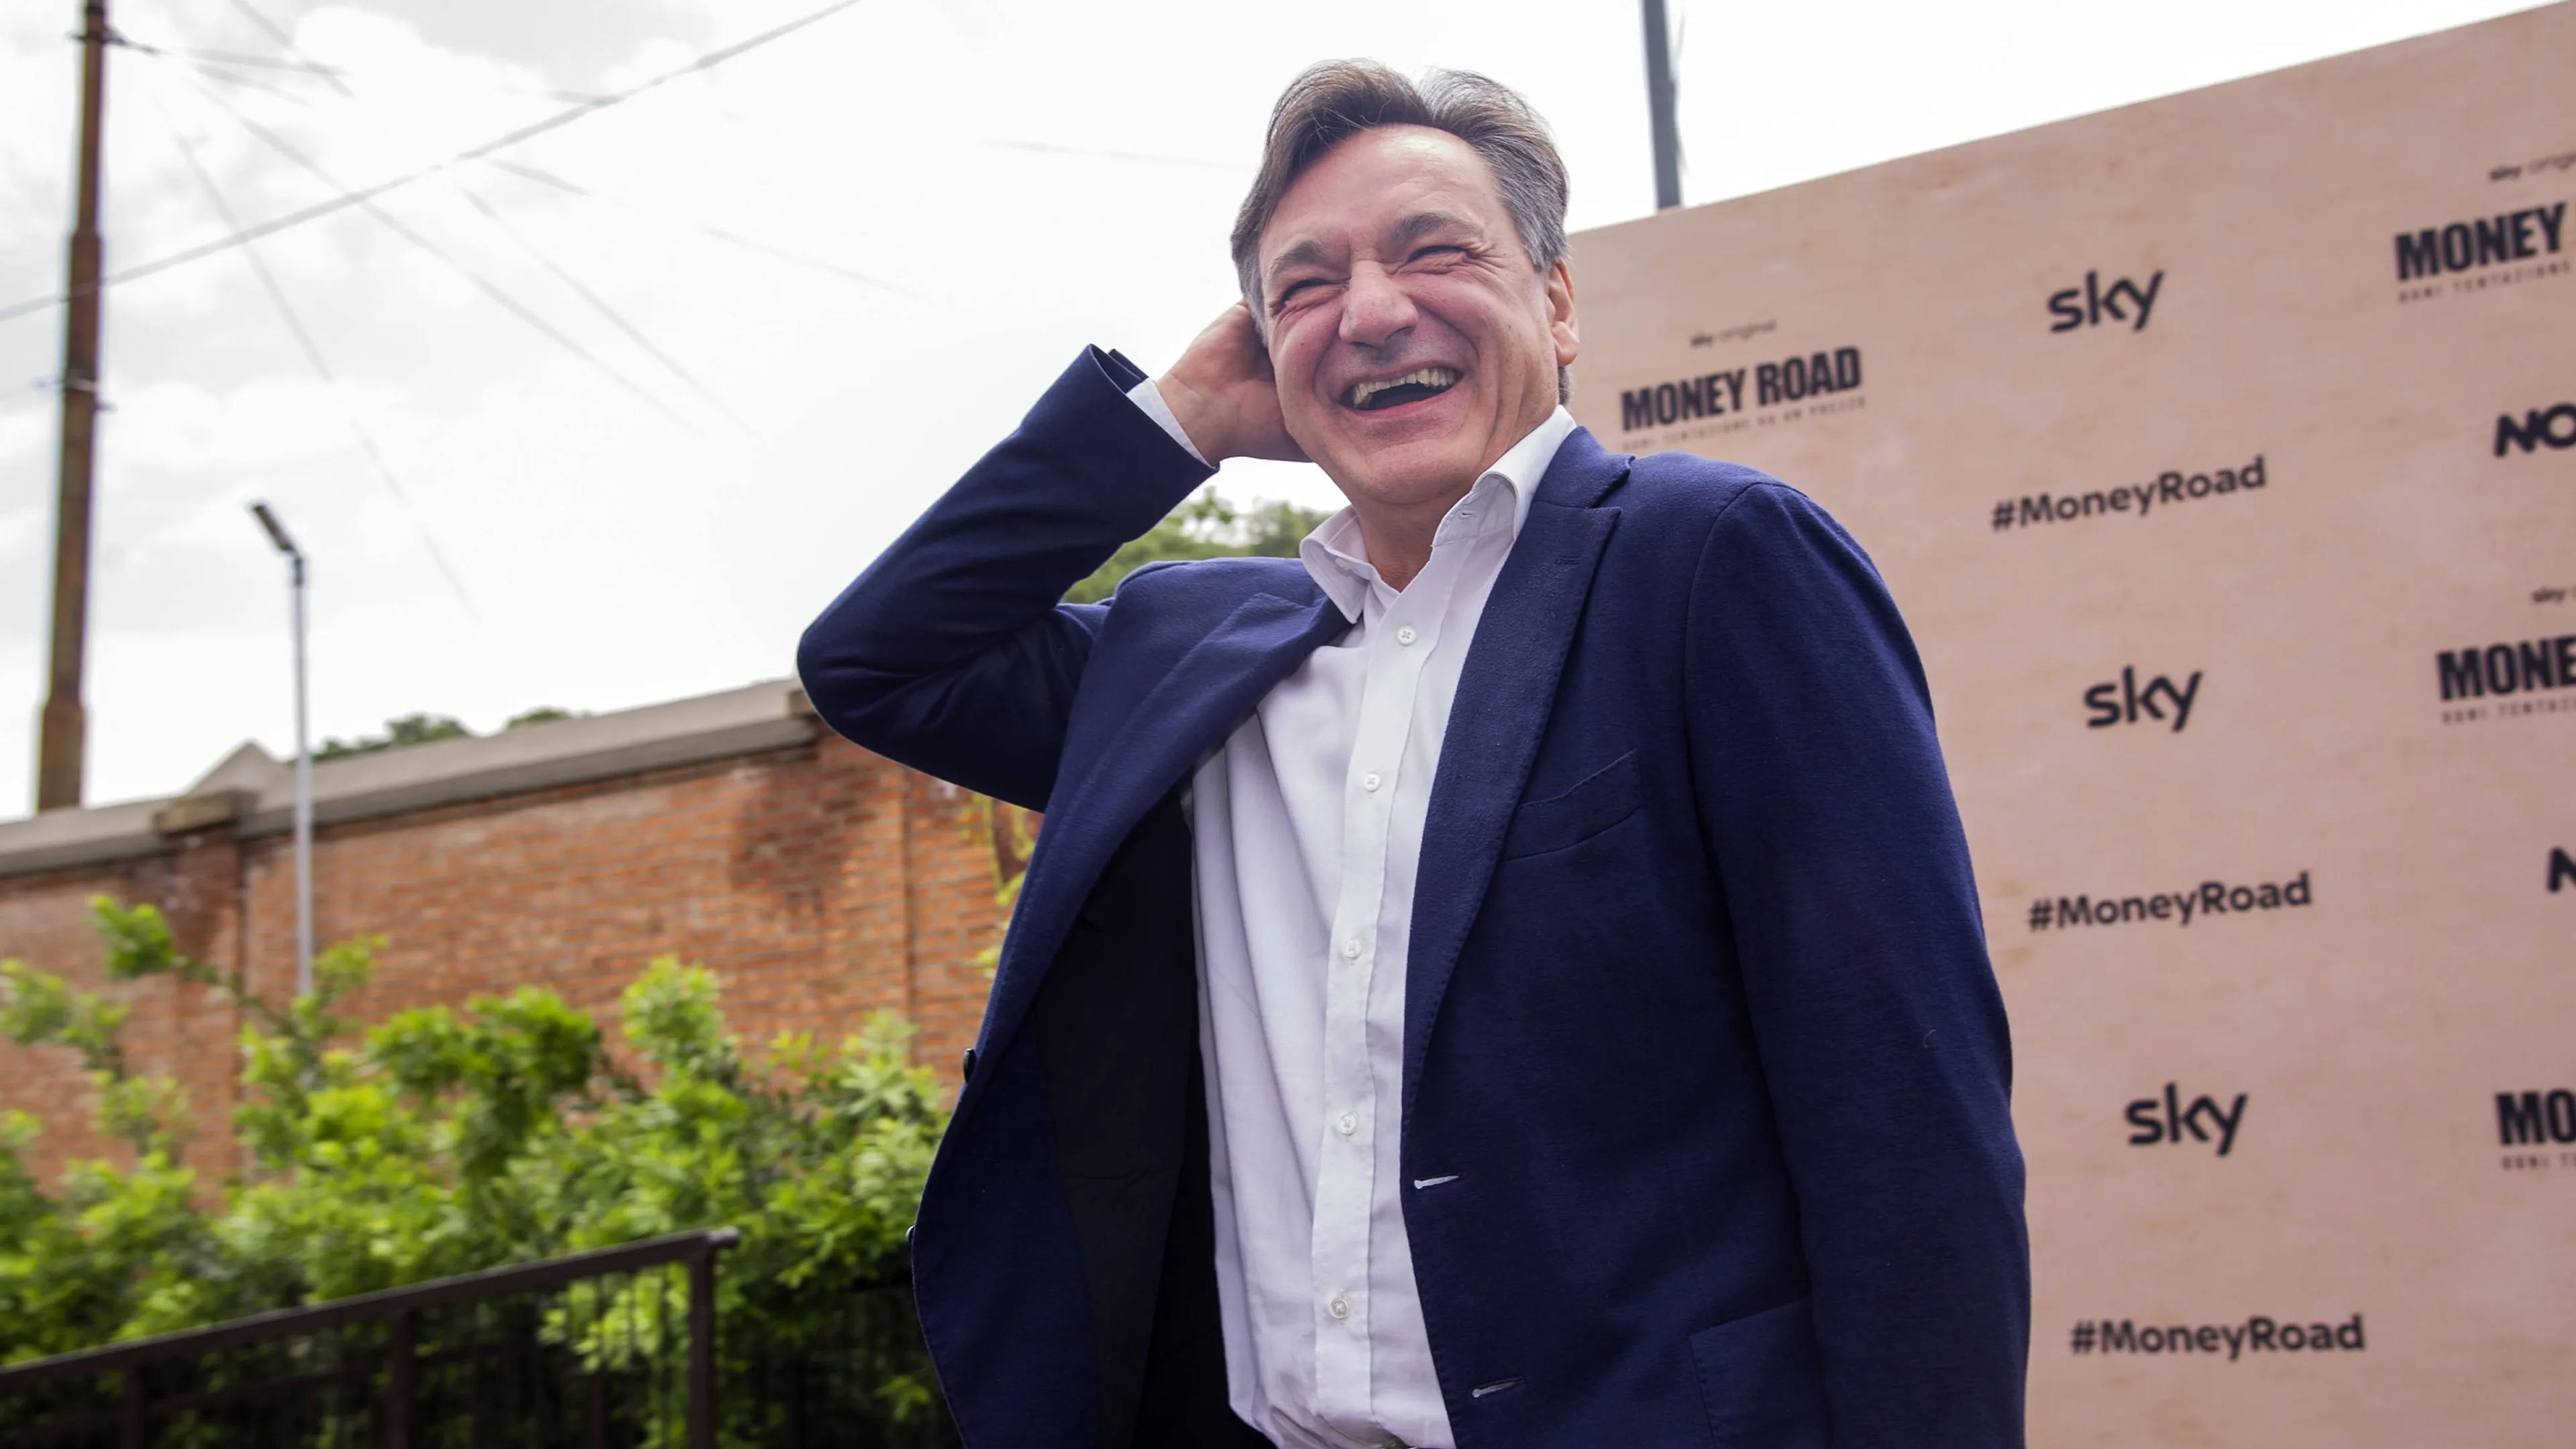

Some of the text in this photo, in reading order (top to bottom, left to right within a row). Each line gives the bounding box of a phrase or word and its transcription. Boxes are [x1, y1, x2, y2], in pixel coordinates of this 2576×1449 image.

[2394, 202, 2566, 282] MONEY
[2046, 270, 2165, 334] sky
[1621, 346, 1862, 432] MONEY ROAD
[1991, 453, 2267, 532] #MoneyRoad
[2082, 665, 2204, 733] sky
[2436, 635, 2576, 702] MONE
[2028, 869, 2313, 932] #MoneyRoad
[2124, 1081, 2249, 1158] sky
[2493, 1087, 2576, 1146] MO
[2070, 1312, 2367, 1363] #MoneyRoad
